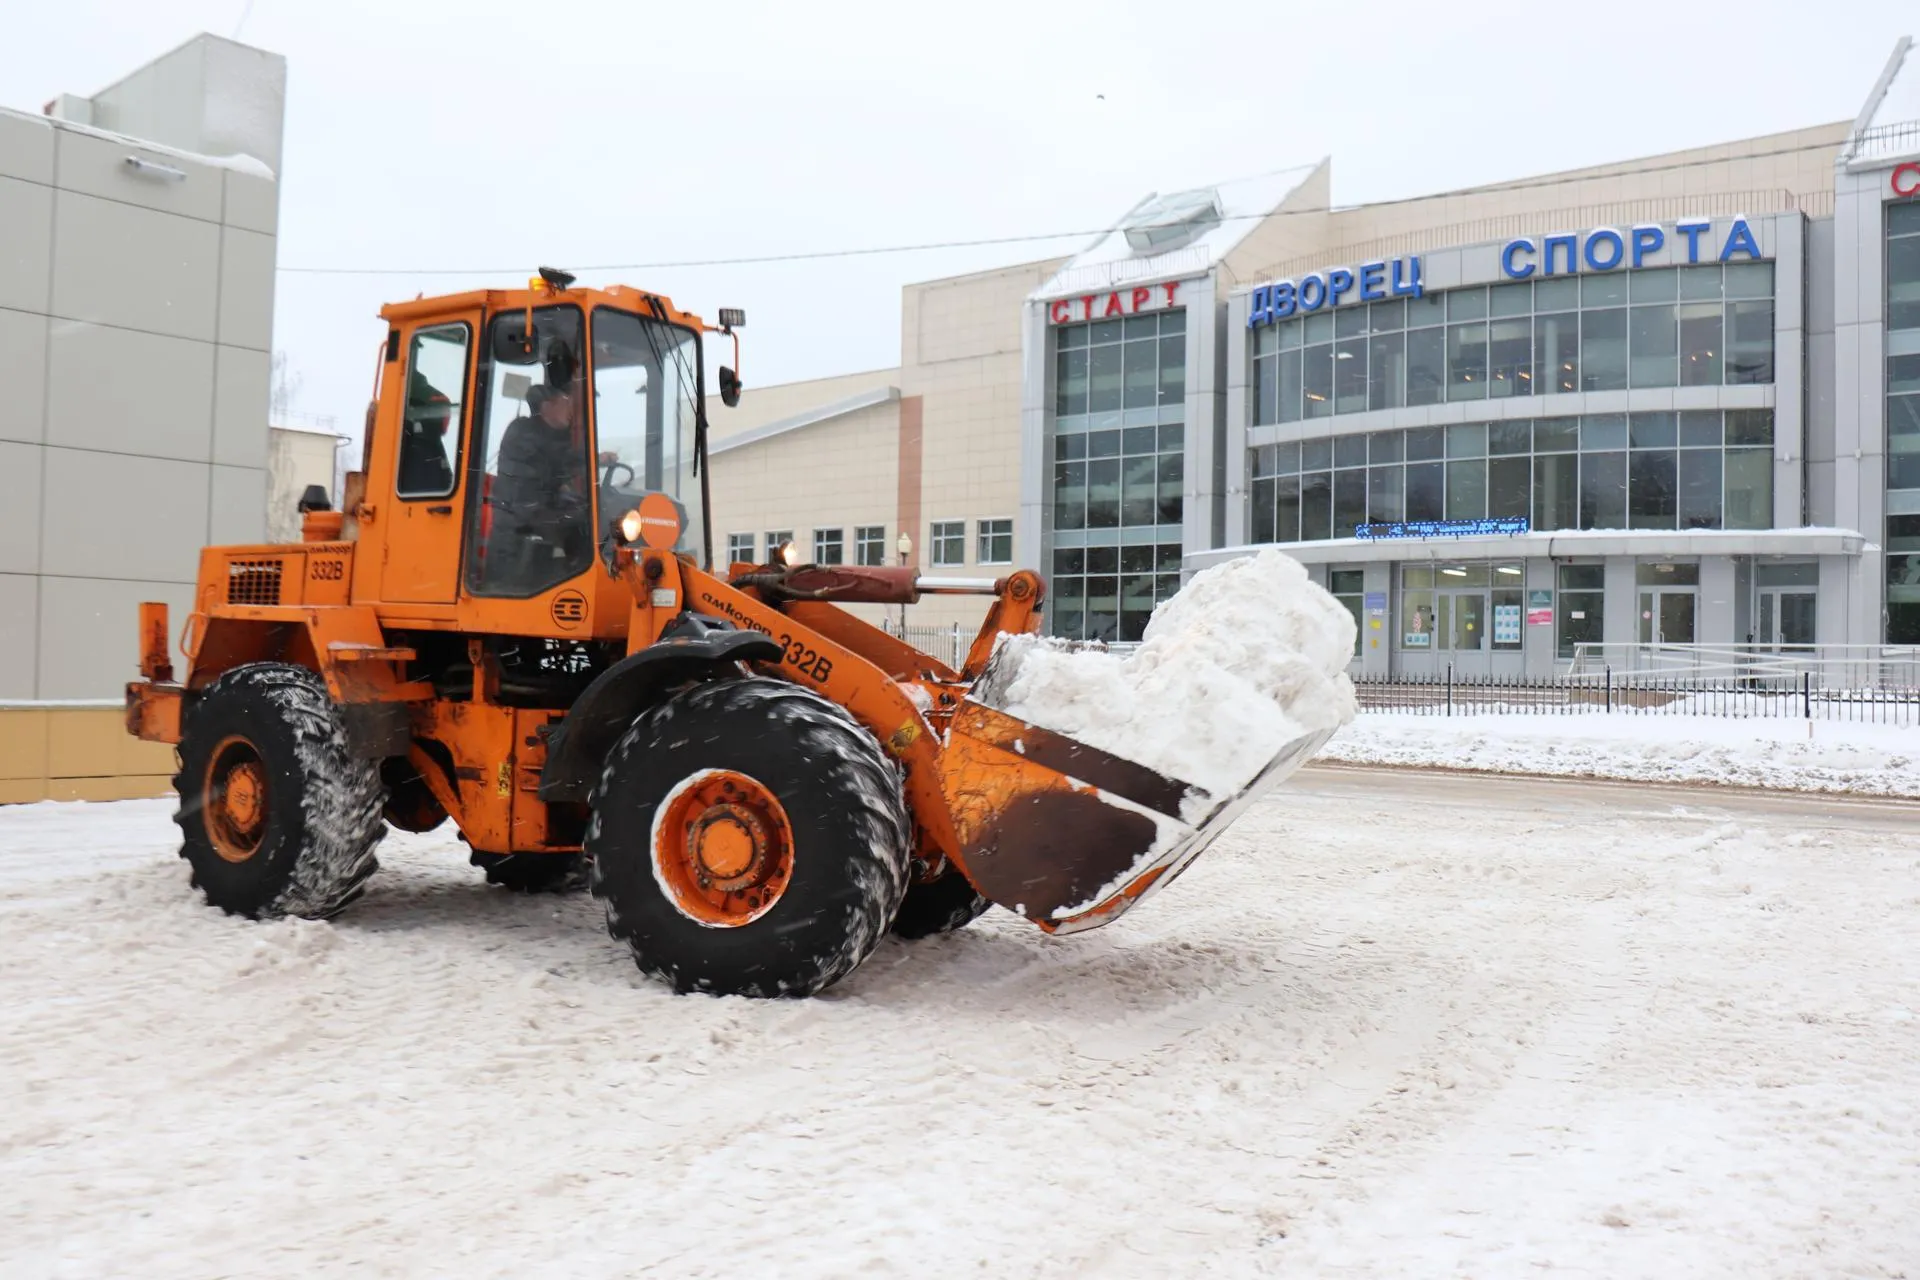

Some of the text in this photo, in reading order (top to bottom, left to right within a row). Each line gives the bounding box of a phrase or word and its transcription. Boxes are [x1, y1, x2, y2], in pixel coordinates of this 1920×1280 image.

[1248, 215, 1762, 328] ДВОРЕЦ СПОРТА
[1051, 281, 1180, 323] СТАРТ
[311, 560, 344, 580] 332B
[779, 633, 833, 683] 332B
